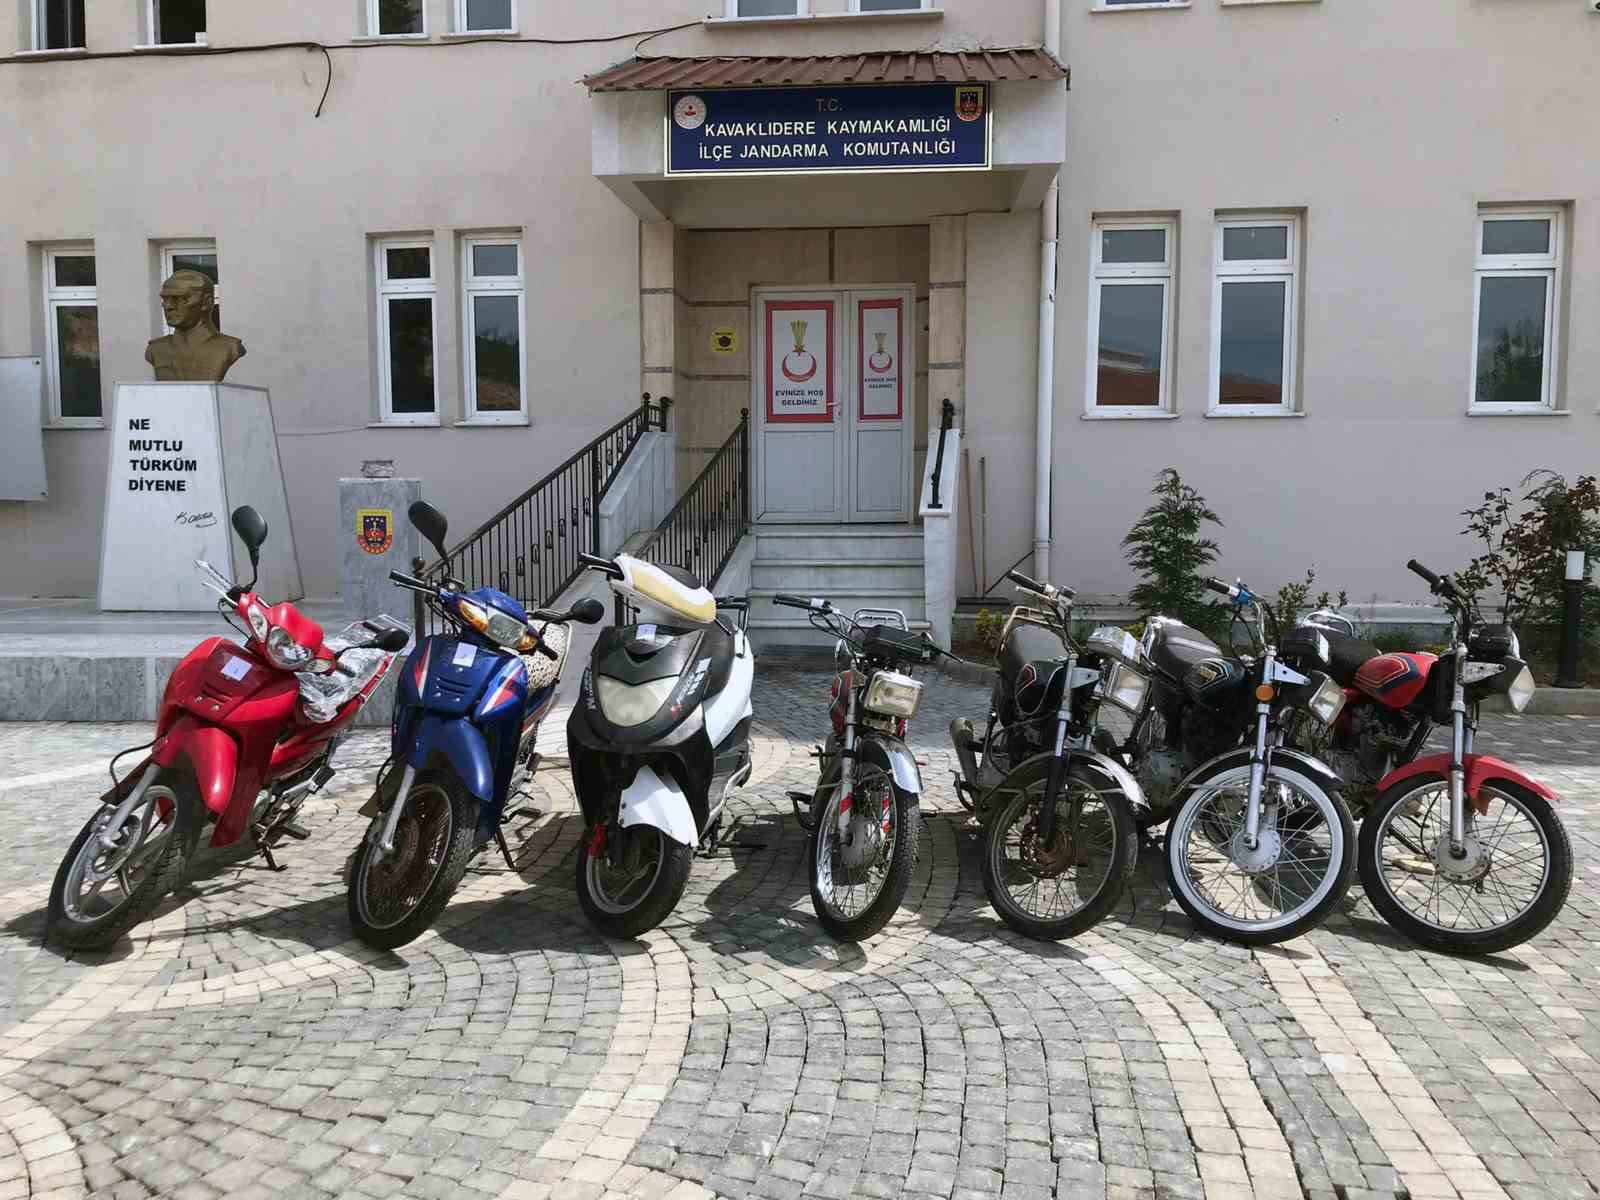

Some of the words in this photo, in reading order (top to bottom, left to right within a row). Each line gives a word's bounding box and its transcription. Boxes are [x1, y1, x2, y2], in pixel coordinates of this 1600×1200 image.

[816, 98, 843, 112] T.C.
[705, 121, 816, 137] KAVAKLIDERE
[827, 116, 951, 135] KAYMAKAMLIĞI
[699, 142, 733, 161] İLÇE
[740, 143, 829, 159] JANDARMA
[843, 138, 956, 156] KOMUTANLIĞI
[129, 418, 151, 431] NE
[129, 439, 183, 452] MUTLU
[129, 457, 197, 472] TÜRKÜM
[128, 476, 186, 492] DİYENE
